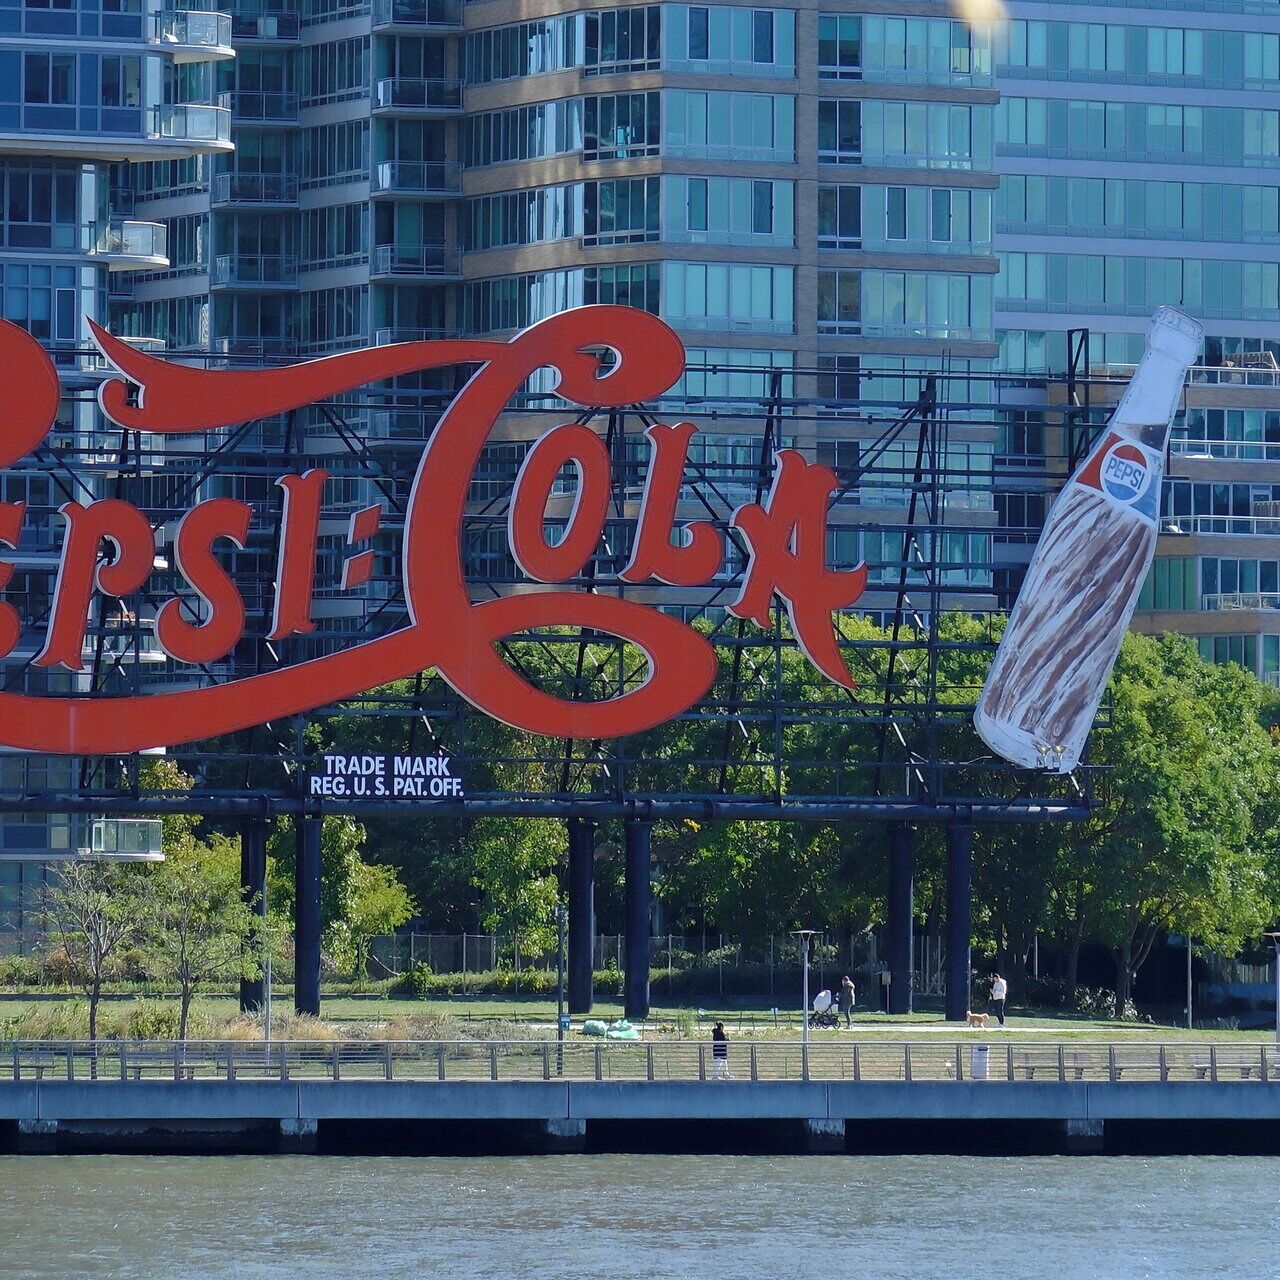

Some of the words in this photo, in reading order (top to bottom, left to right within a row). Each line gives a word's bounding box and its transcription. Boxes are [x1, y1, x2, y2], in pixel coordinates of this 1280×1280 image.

[1105, 457, 1146, 490] PEPSI
[323, 755, 386, 776] TRADE
[393, 756, 451, 776] MARK
[310, 776, 352, 796] REG.
[393, 777, 428, 797] PAT.
[429, 777, 464, 797] OFF.
